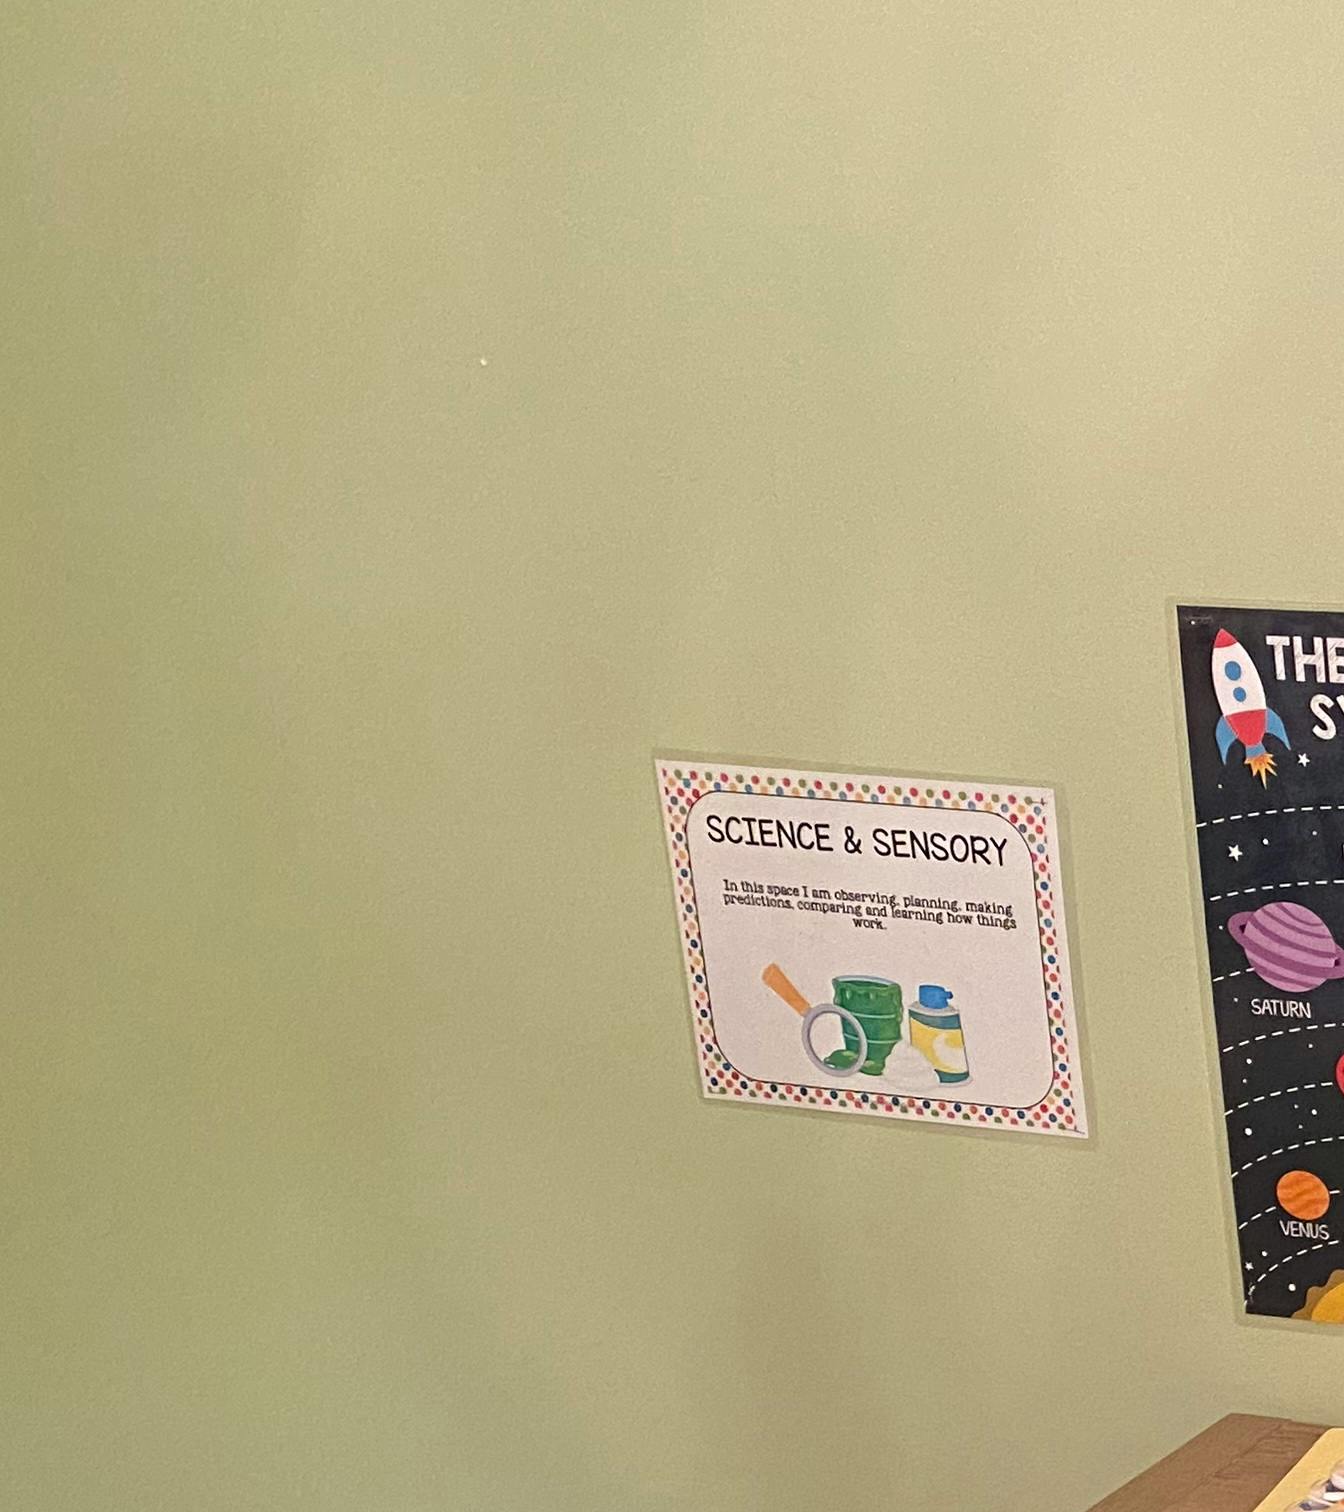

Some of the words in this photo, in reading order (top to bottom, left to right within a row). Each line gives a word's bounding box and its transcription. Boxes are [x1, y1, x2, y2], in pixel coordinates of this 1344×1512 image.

[706, 815, 834, 851] SCIENCE
[844, 826, 863, 854] &
[872, 828, 1007, 866] SENSORY
[723, 879, 738, 891] In
[741, 881, 764, 893] this
[767, 884, 800, 896] space
[812, 889, 831, 899] am
[965, 901, 1013, 917] making
[797, 901, 862, 917] comparing
[865, 906, 887, 917] and
[891, 906, 943, 925] learning
[947, 912, 973, 924] how
[977, 914, 1017, 930] things
[852, 917, 888, 931] work.
[1250, 998, 1313, 1019] SATURN
[1279, 1220, 1330, 1240] VENUS
